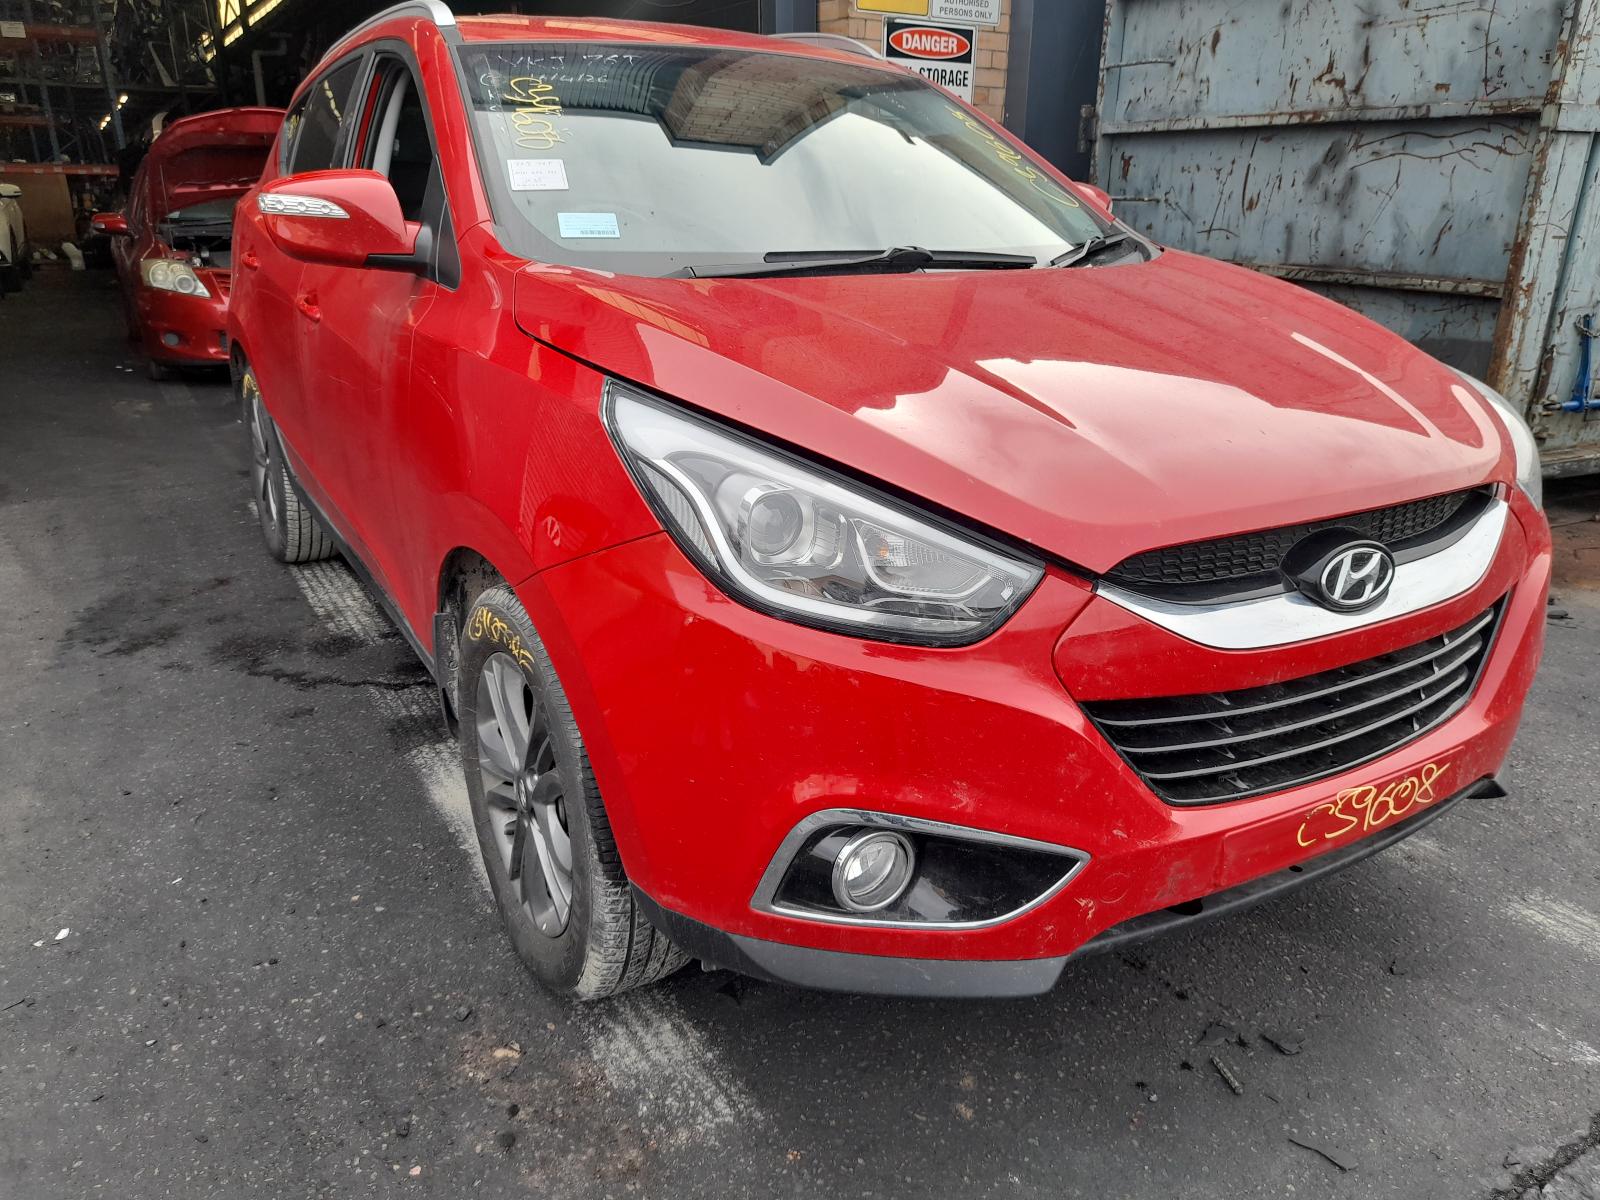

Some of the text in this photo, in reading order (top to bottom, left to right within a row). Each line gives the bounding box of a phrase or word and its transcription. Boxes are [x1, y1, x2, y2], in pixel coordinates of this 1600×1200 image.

[939, 7, 993, 20] PERSONS ONLY
[902, 33, 958, 53] DANGER
[1297, 763, 1451, 847] C59608
